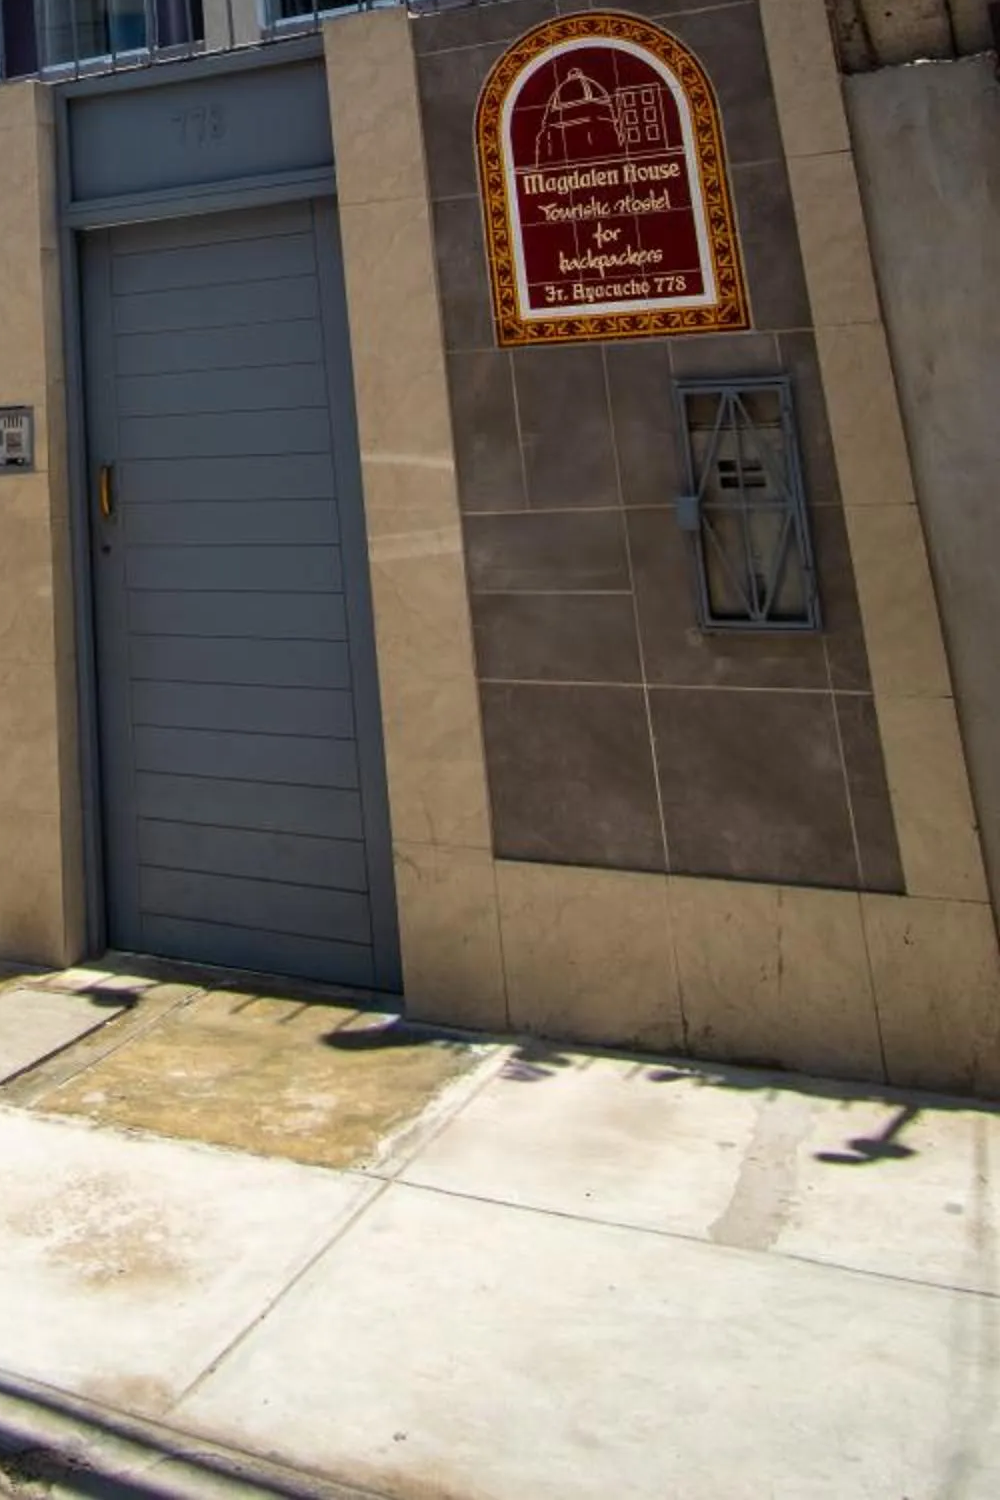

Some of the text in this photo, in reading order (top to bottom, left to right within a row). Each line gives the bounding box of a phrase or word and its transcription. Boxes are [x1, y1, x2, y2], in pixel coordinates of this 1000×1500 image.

[523, 162, 681, 195] Magdalen House
[538, 195, 611, 221] Touristic
[592, 221, 622, 249] for
[559, 244, 663, 280] backpackers
[573, 279, 651, 302] Ayacucho
[653, 276, 687, 293] 778
